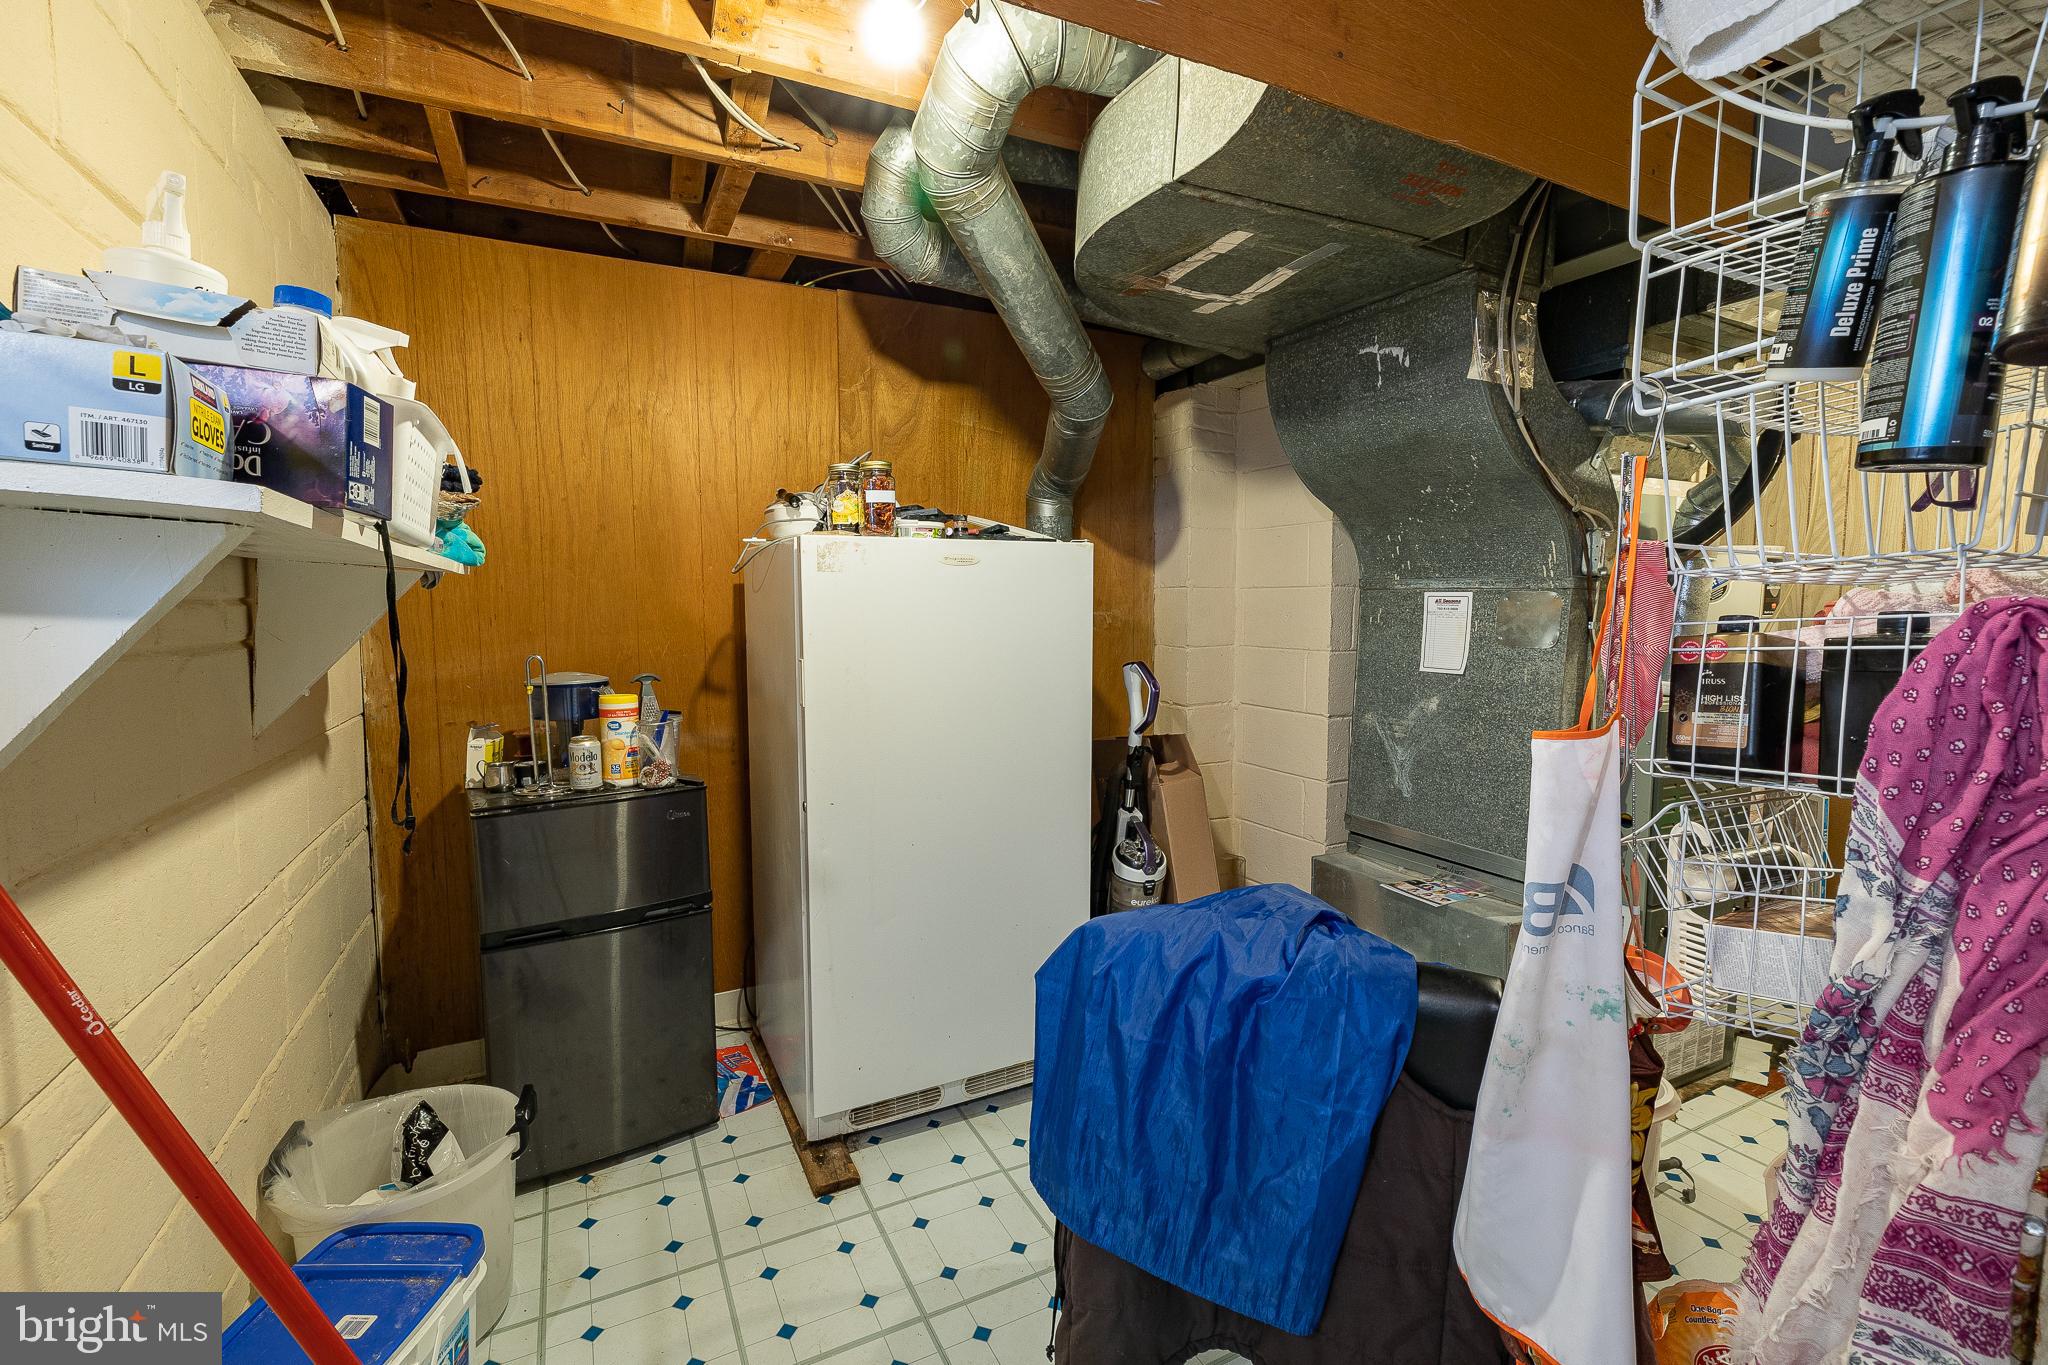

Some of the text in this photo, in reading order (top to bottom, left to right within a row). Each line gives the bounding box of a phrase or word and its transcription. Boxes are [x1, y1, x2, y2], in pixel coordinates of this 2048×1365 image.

[1830, 227, 1879, 337] Deluxe Prime
[1978, 316, 1993, 327] 02
[129, 355, 146, 377] L
[128, 382, 145, 392] LG
[80, 412, 96, 420] ITM.
[121, 417, 148, 426] 467130
[192, 416, 225, 450] GLOVES
[1701, 694, 1723, 702] HIGH
[611, 764, 620, 772] 35
[1690, 1304, 1706, 1313] One
[1684, 1316, 1718, 1325] Countless
